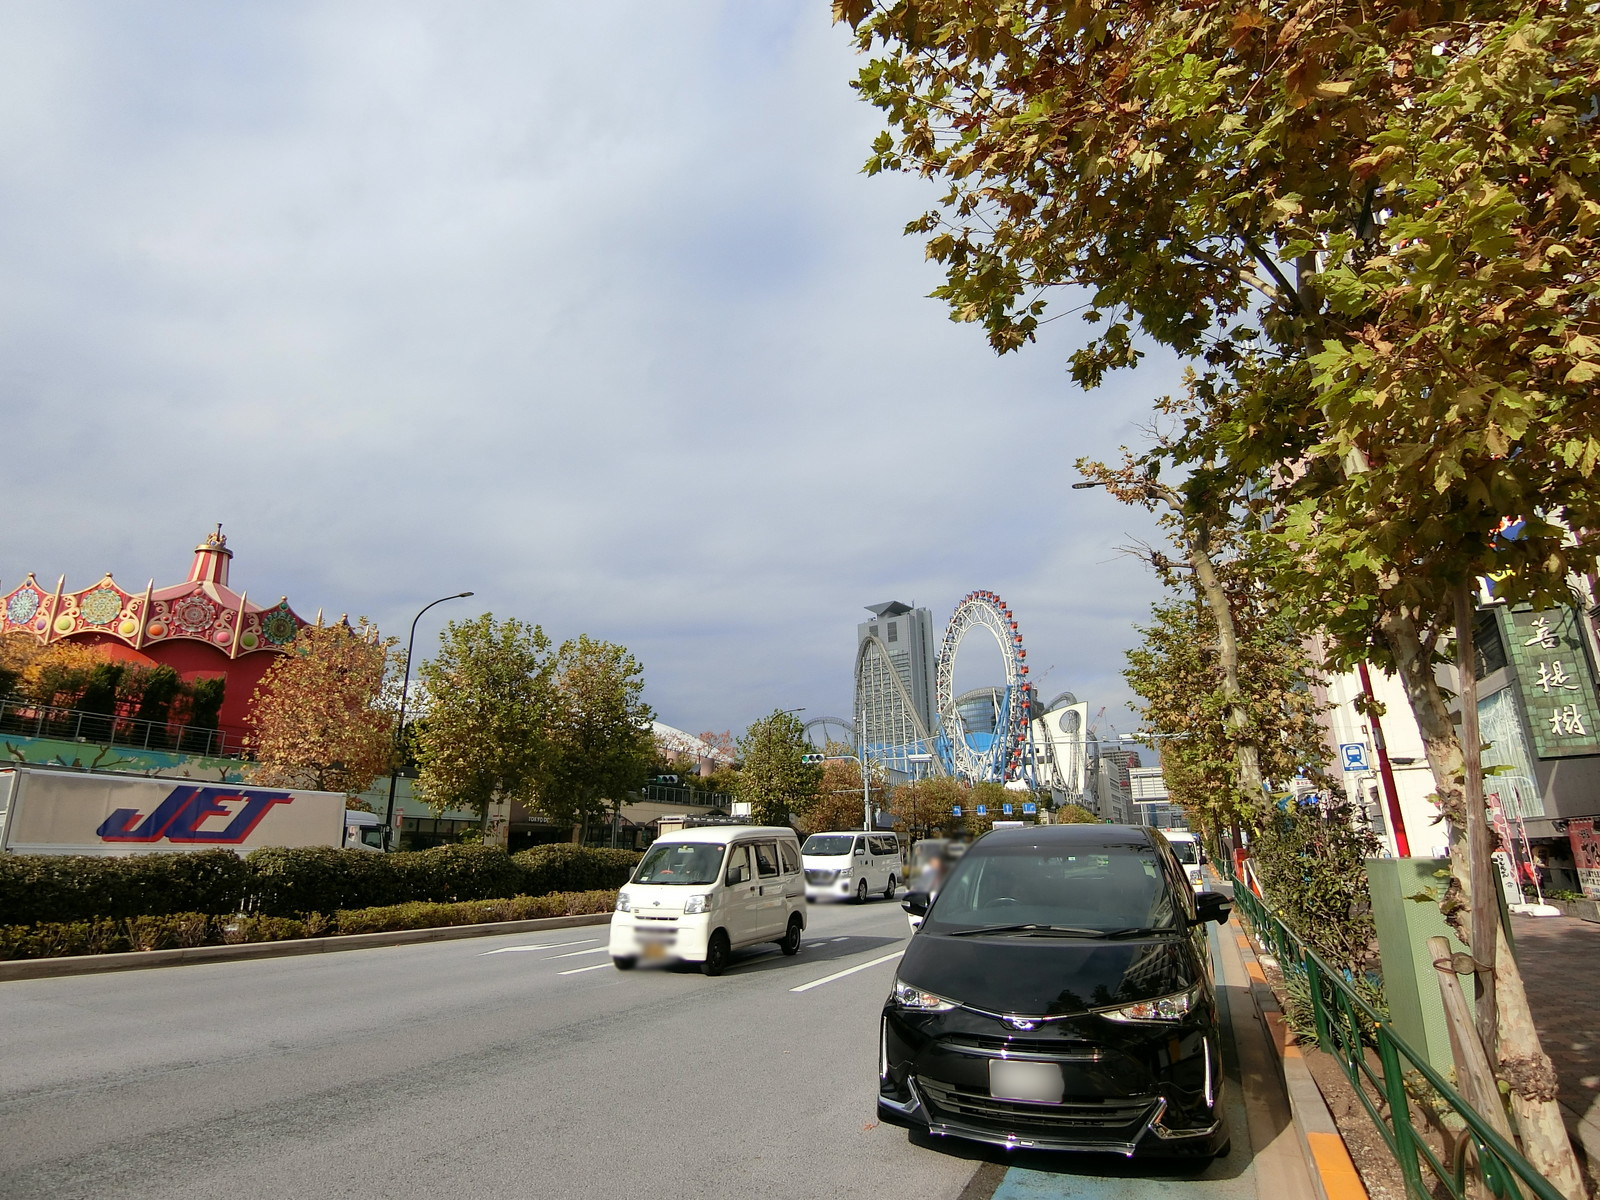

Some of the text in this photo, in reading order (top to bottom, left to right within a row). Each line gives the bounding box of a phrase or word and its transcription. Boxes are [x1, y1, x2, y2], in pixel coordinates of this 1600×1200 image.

[1524, 616, 1586, 736] 菩提樹
[96, 785, 295, 844] JET
